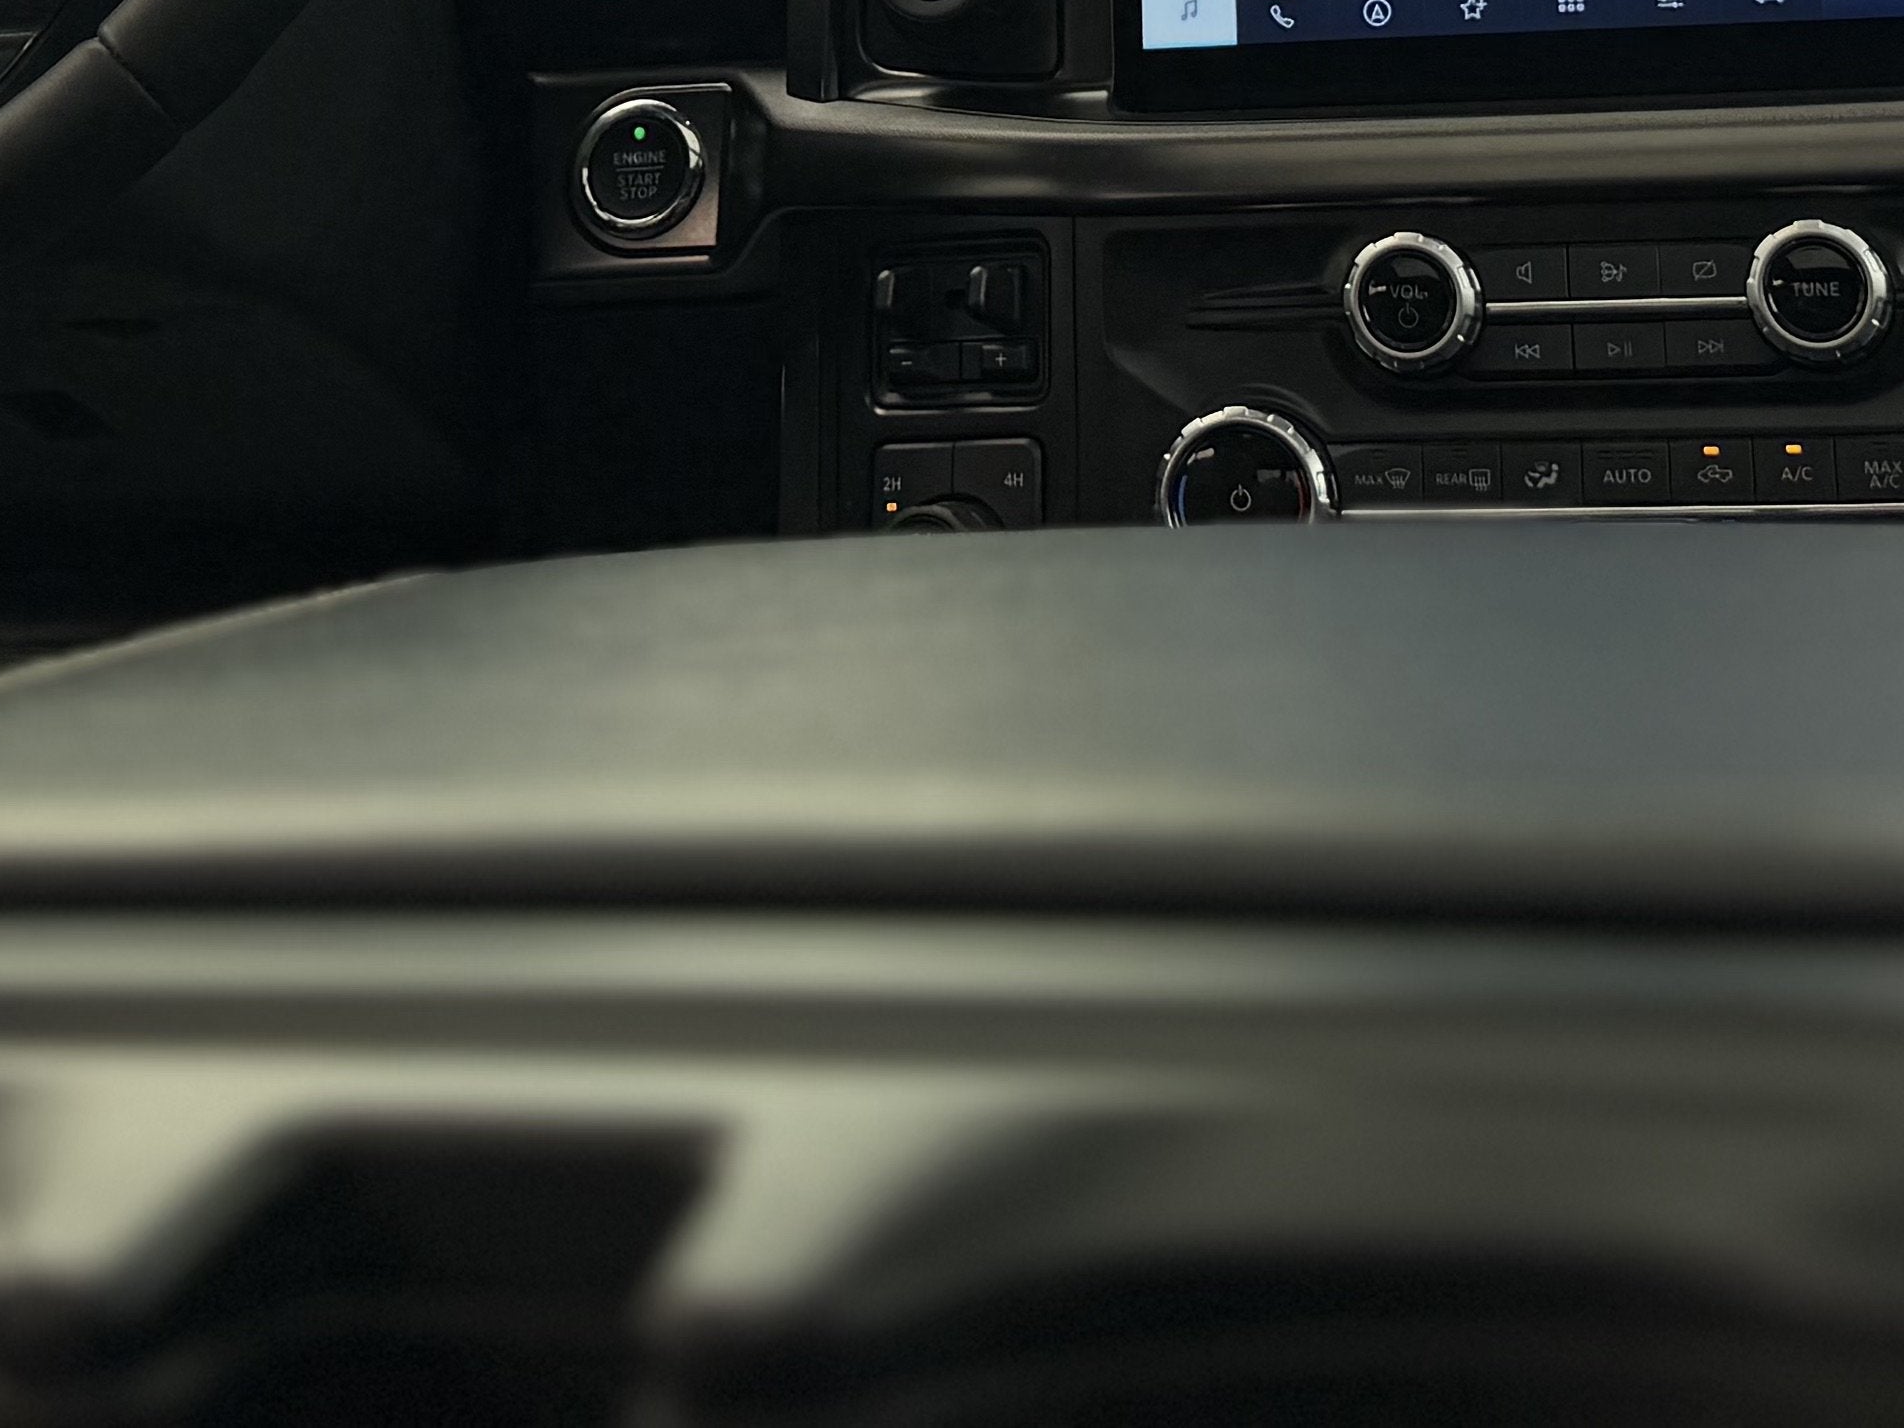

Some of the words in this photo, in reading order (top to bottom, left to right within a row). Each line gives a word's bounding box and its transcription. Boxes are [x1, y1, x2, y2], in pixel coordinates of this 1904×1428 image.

[613, 148, 667, 164] ENGINE
[617, 172, 662, 187] START
[619, 187, 658, 200] STOP
[1390, 285, 1428, 300] VOL
[1791, 280, 1841, 299] TUNE
[1602, 467, 1653, 485] AUTO
[1780, 464, 1814, 483] A/C
[1863, 460, 1904, 477] MAX
[882, 475, 903, 492] 2H
[1002, 472, 1025, 488] 4H
[1355, 474, 1384, 486] MAX
[1435, 472, 1469, 486] REAR
[1869, 472, 1901, 489] A/C
